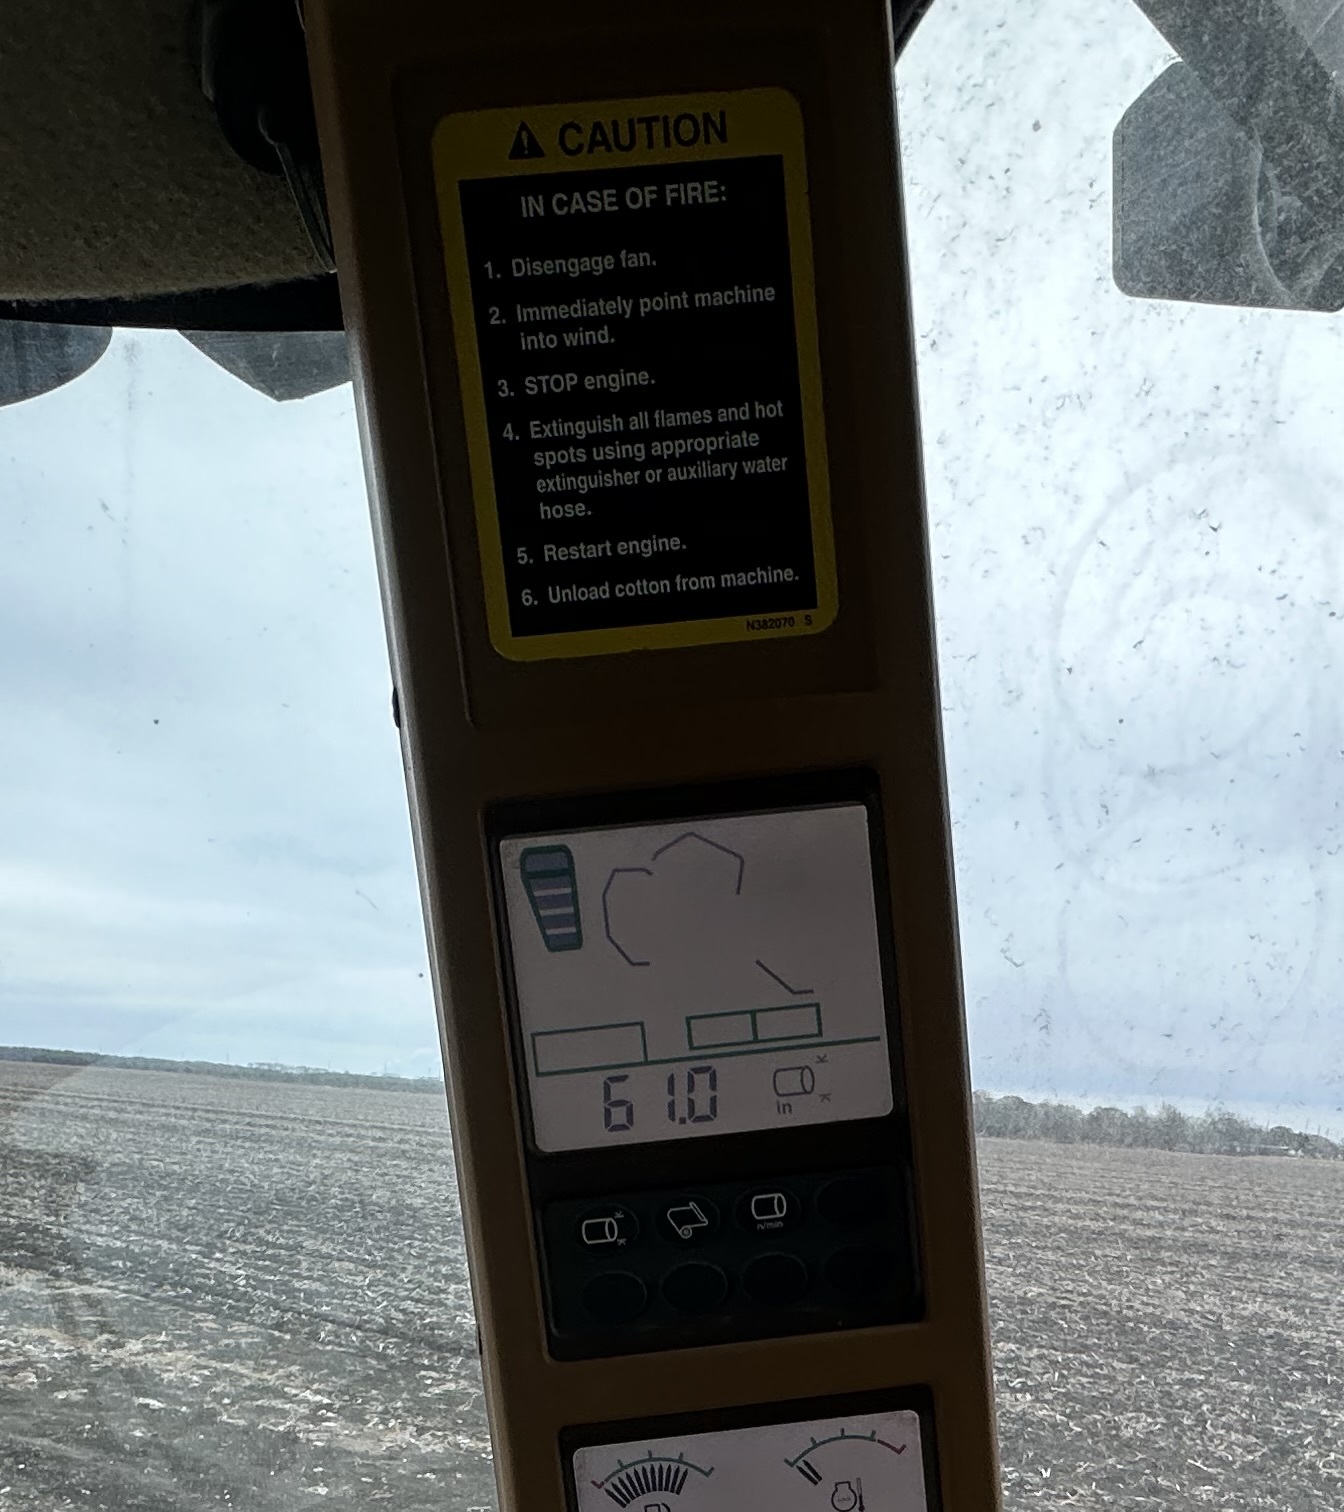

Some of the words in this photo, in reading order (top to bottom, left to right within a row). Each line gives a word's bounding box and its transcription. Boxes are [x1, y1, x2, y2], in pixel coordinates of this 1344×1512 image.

[558, 111, 728, 156] CAUTION
[520, 196, 545, 218] IN
[552, 189, 618, 215] CASE
[625, 186, 657, 210] OF
[666, 182, 727, 205] FIRE:
[484, 262, 501, 279] 1.
[512, 253, 615, 277] Disengage
[620, 250, 656, 268] fan.
[490, 307, 506, 324] 2.
[517, 296, 633, 323] Immediately
[639, 291, 689, 317] point
[694, 285, 776, 306] machine
[520, 333, 557, 350] into
[563, 326, 615, 347] wind.
[497, 380, 514, 397] 3.
[524, 373, 578, 395] STOP
[584, 369, 655, 392] engine.
[503, 423, 519, 440] 4.
[530, 416, 624, 440] Extinguish
[629, 412, 649, 429] all
[655, 407, 712, 427] flames
[718, 403, 750, 423] and
[755, 401, 784, 418] hot
[534, 445, 587, 468] spots
[593, 442, 645, 462] using
[651, 431, 759, 458] appropriate
[536, 471, 640, 494] extinguisher
[645, 467, 662, 483] or
[667, 462, 737, 482] auxiliary
[742, 456, 788, 474] water
[539, 502, 592, 519] hose.
[517, 548, 533, 564] 5.
[544, 541, 612, 562] Restart
[617, 535, 686, 558] engine.
[521, 589, 538, 606] 6.
[548, 582, 609, 603] Unload
[615, 578, 670, 598] cotton
[675, 574, 715, 591] from
[721, 566, 799, 588] machine.
